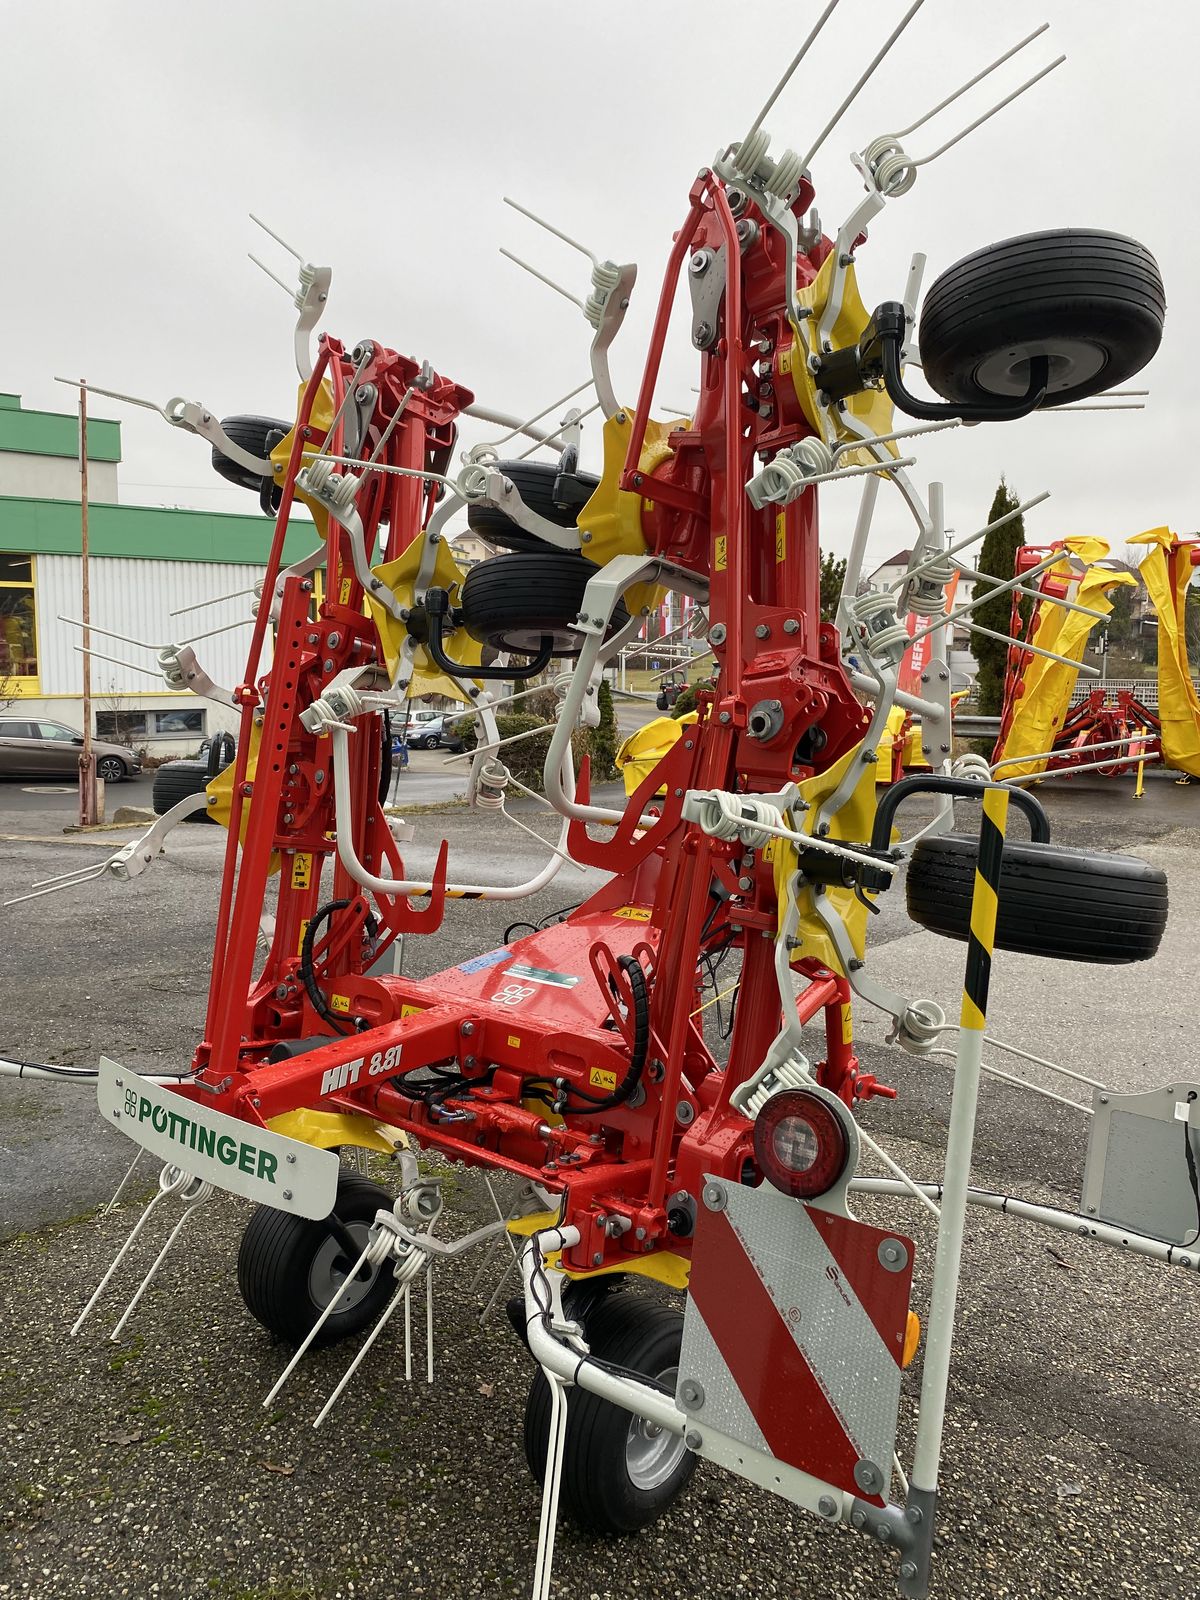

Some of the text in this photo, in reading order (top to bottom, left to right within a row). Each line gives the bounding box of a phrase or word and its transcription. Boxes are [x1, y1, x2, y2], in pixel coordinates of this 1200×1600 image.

[320, 1044, 403, 1096] HIT 8.81
[138, 1096, 279, 1184] PÖTTINGER
